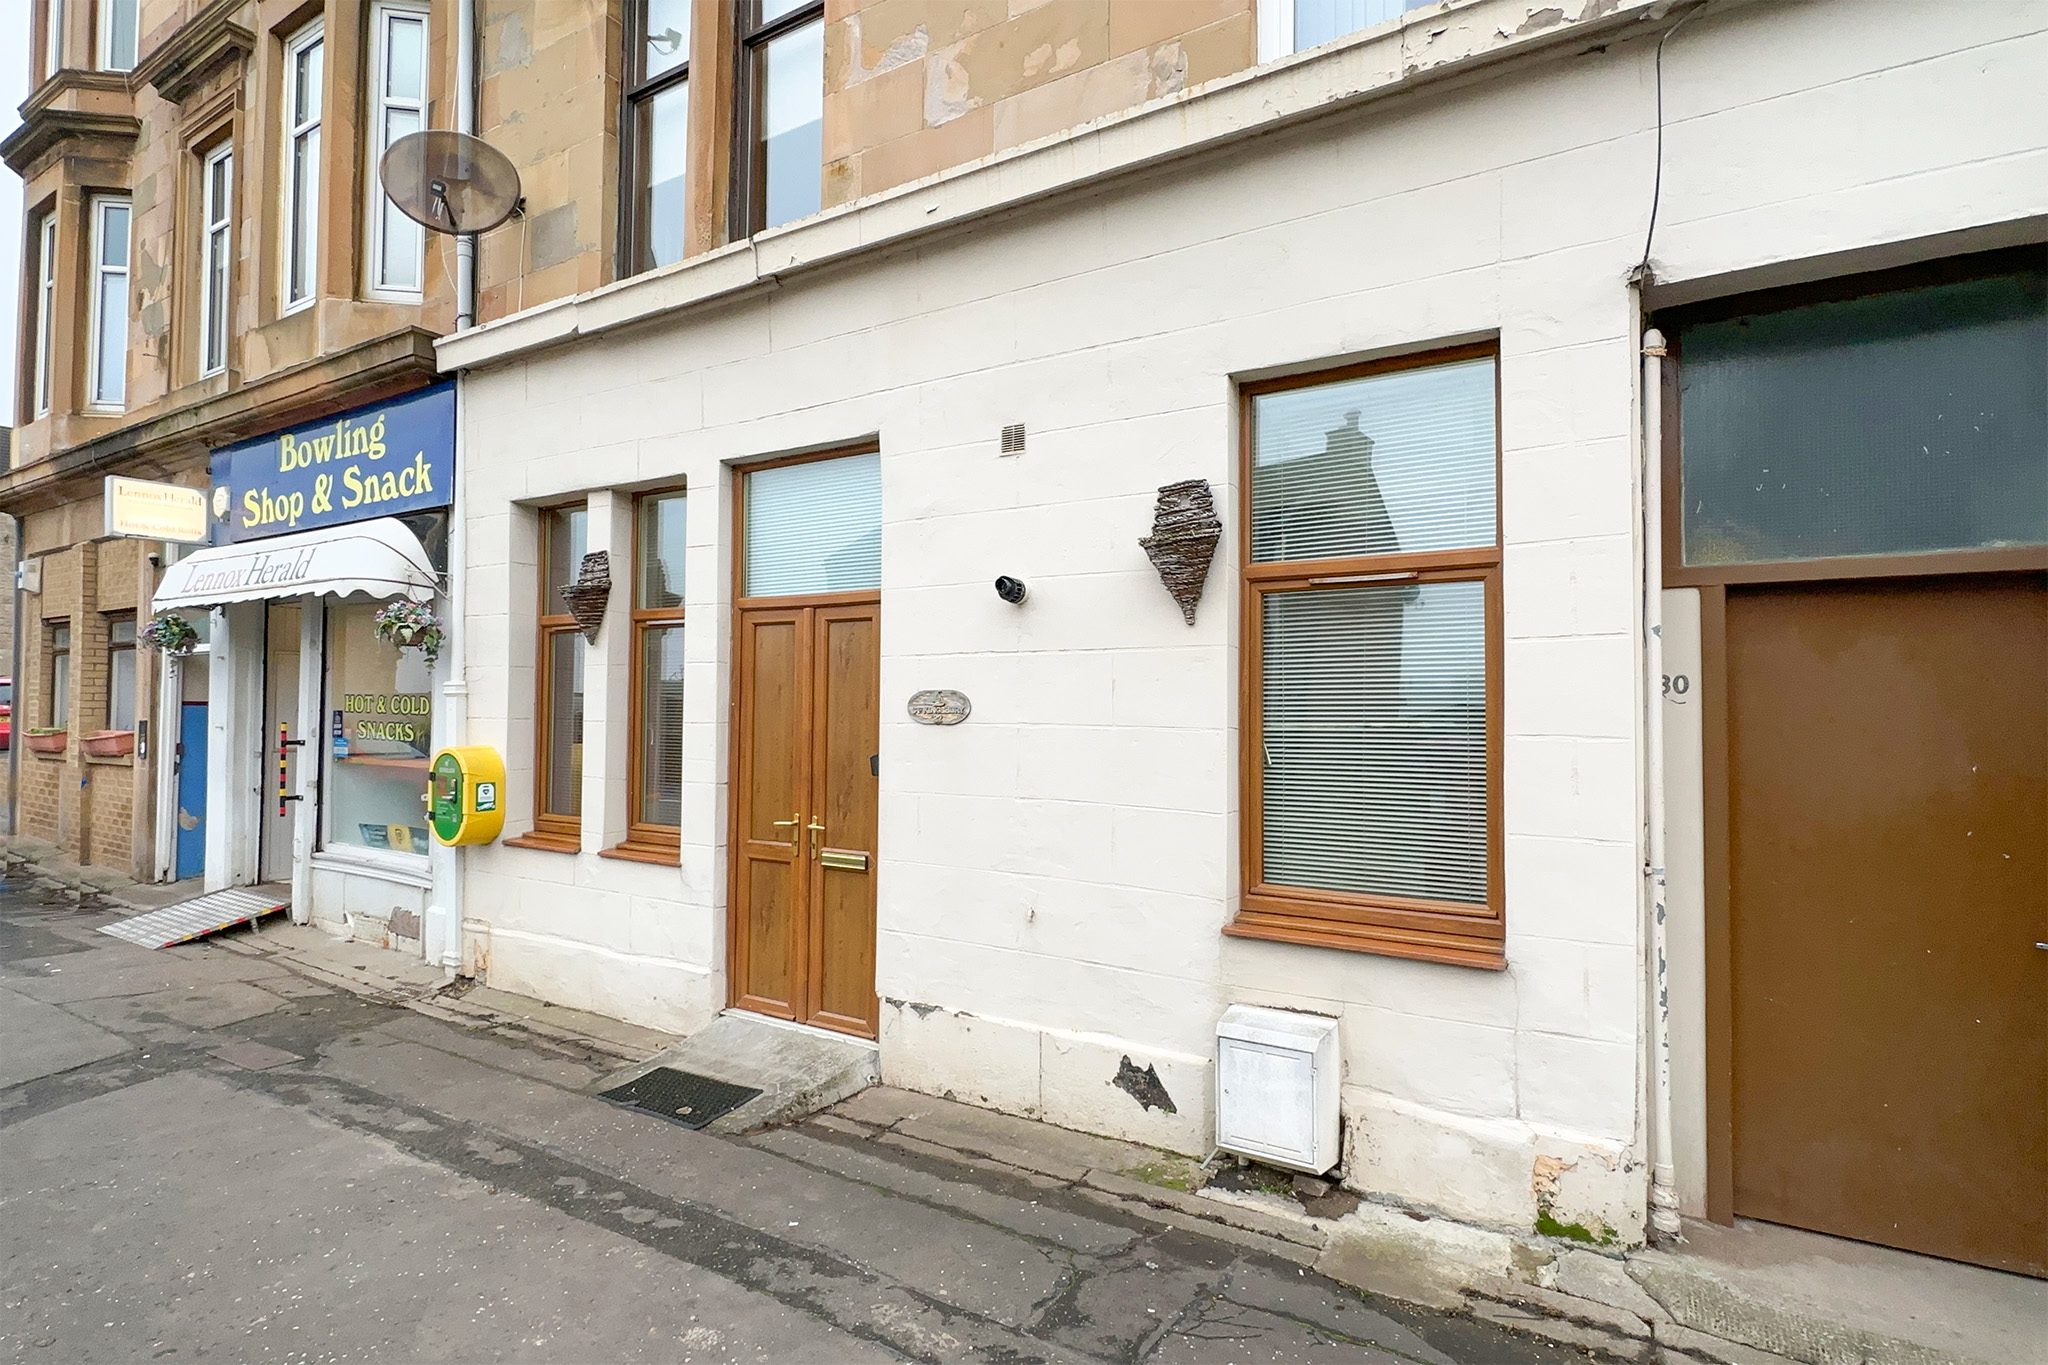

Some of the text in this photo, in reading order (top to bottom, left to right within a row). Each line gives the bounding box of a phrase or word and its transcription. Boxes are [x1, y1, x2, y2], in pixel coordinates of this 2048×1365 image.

[279, 413, 387, 473] Bowling
[242, 450, 433, 529] Shop & Snack
[180, 546, 317, 593] Lennox Herald
[344, 693, 431, 716] HOT & COLD
[357, 720, 415, 743] SNACKS
